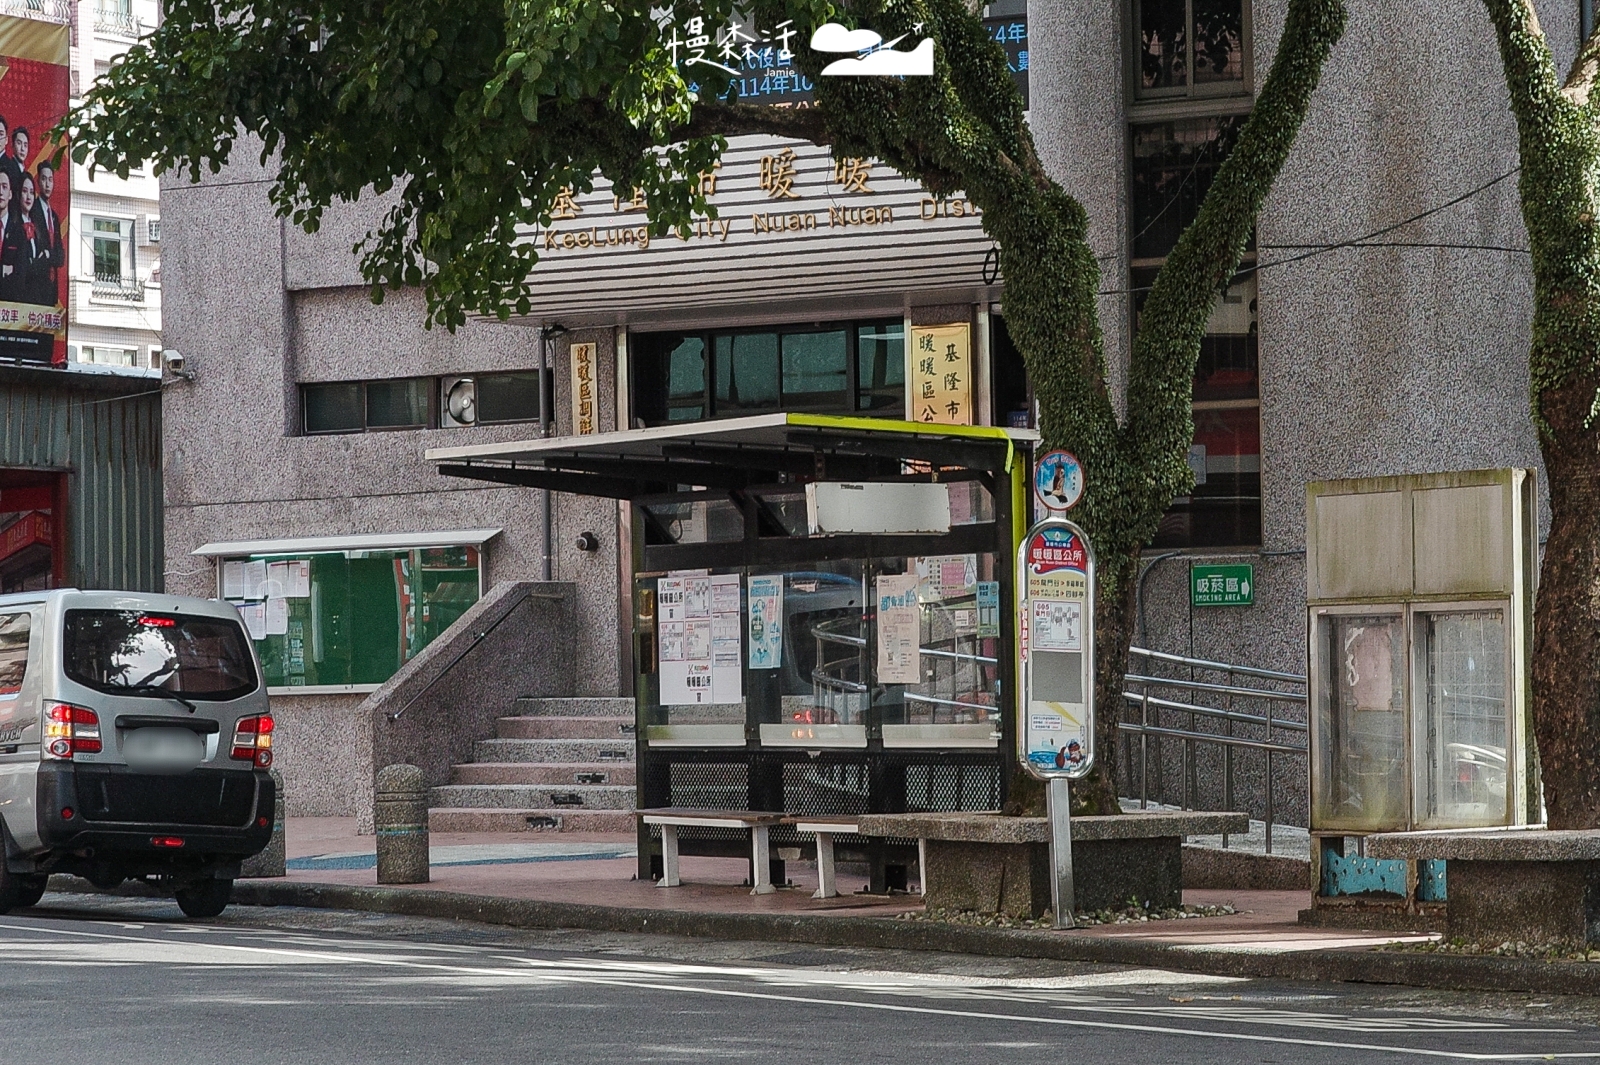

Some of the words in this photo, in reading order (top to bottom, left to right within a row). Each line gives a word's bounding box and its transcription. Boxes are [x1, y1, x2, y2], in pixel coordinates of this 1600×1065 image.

[752, 213, 816, 235] Nuan
[828, 205, 894, 228] Nuan
[919, 333, 938, 422] 暖暖區公
[944, 343, 962, 420] 基隆市
[1033, 548, 1083, 562] 暖暖區公所
[1196, 576, 1239, 593] 吸菸區
[1195, 593, 1222, 602] SMOKING
[1225, 593, 1241, 601] AREA
